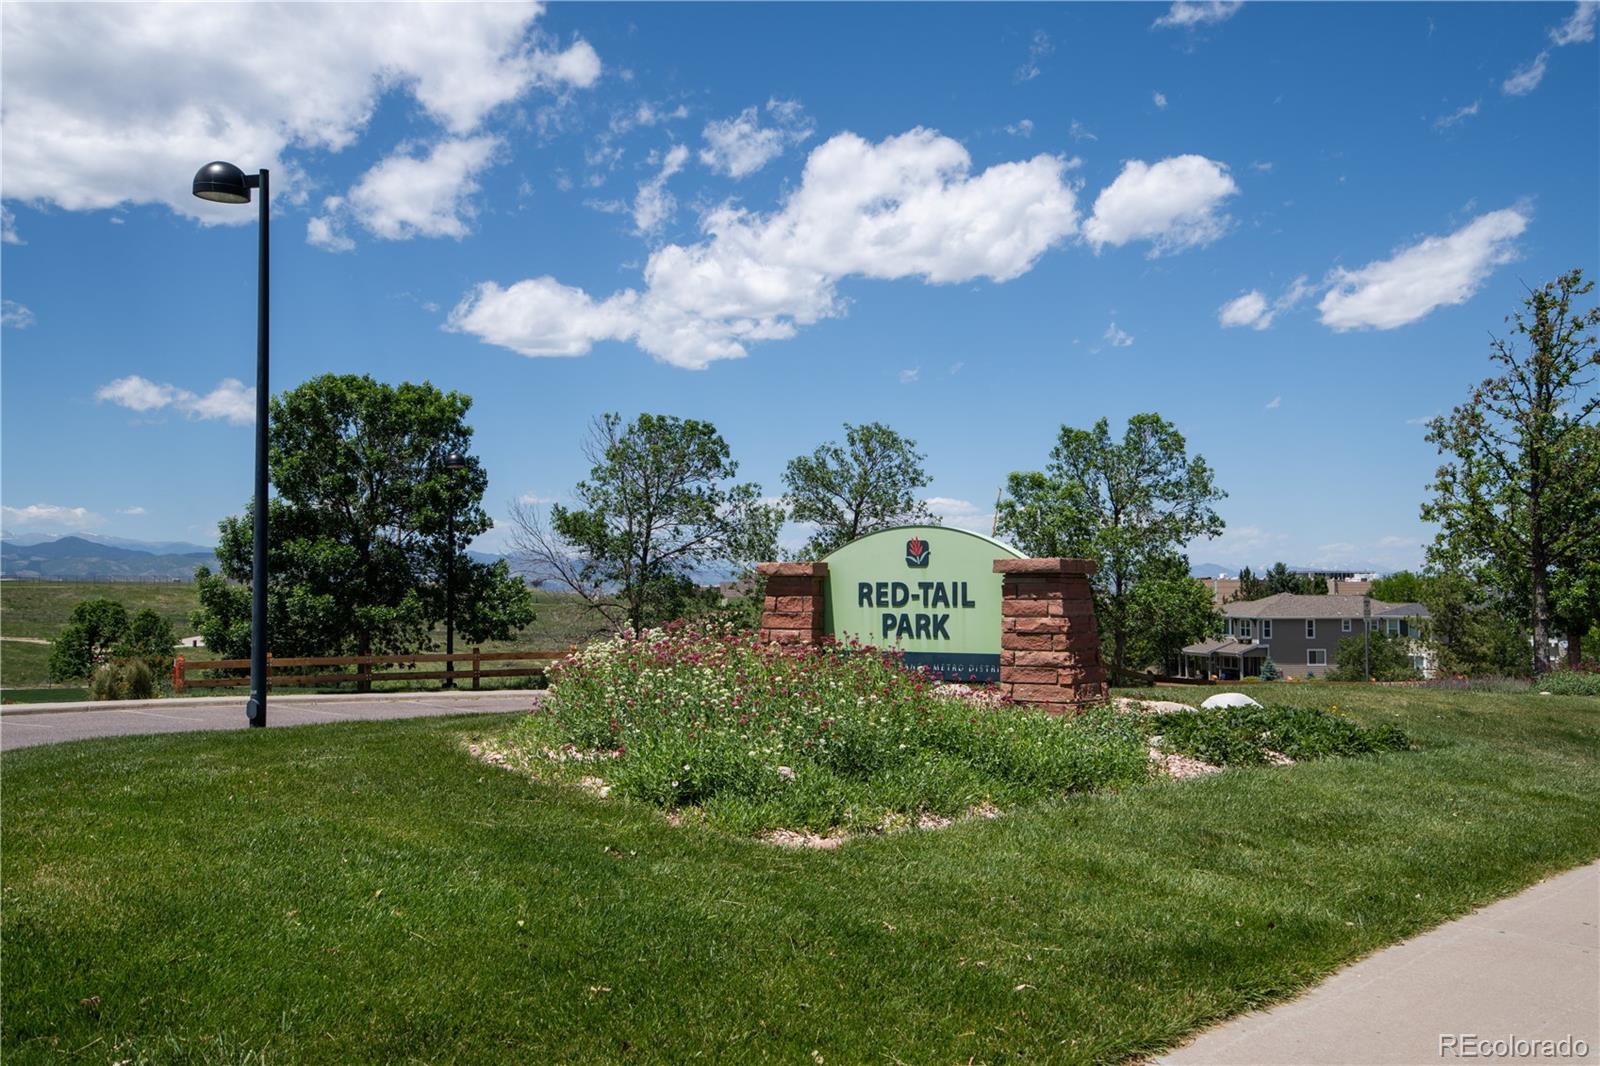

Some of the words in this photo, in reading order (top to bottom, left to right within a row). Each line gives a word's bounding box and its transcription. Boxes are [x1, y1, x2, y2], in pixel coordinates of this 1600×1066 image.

[858, 582, 976, 608] RED-TAIL
[882, 613, 950, 640] PARK
[933, 663, 964, 672] METRO
